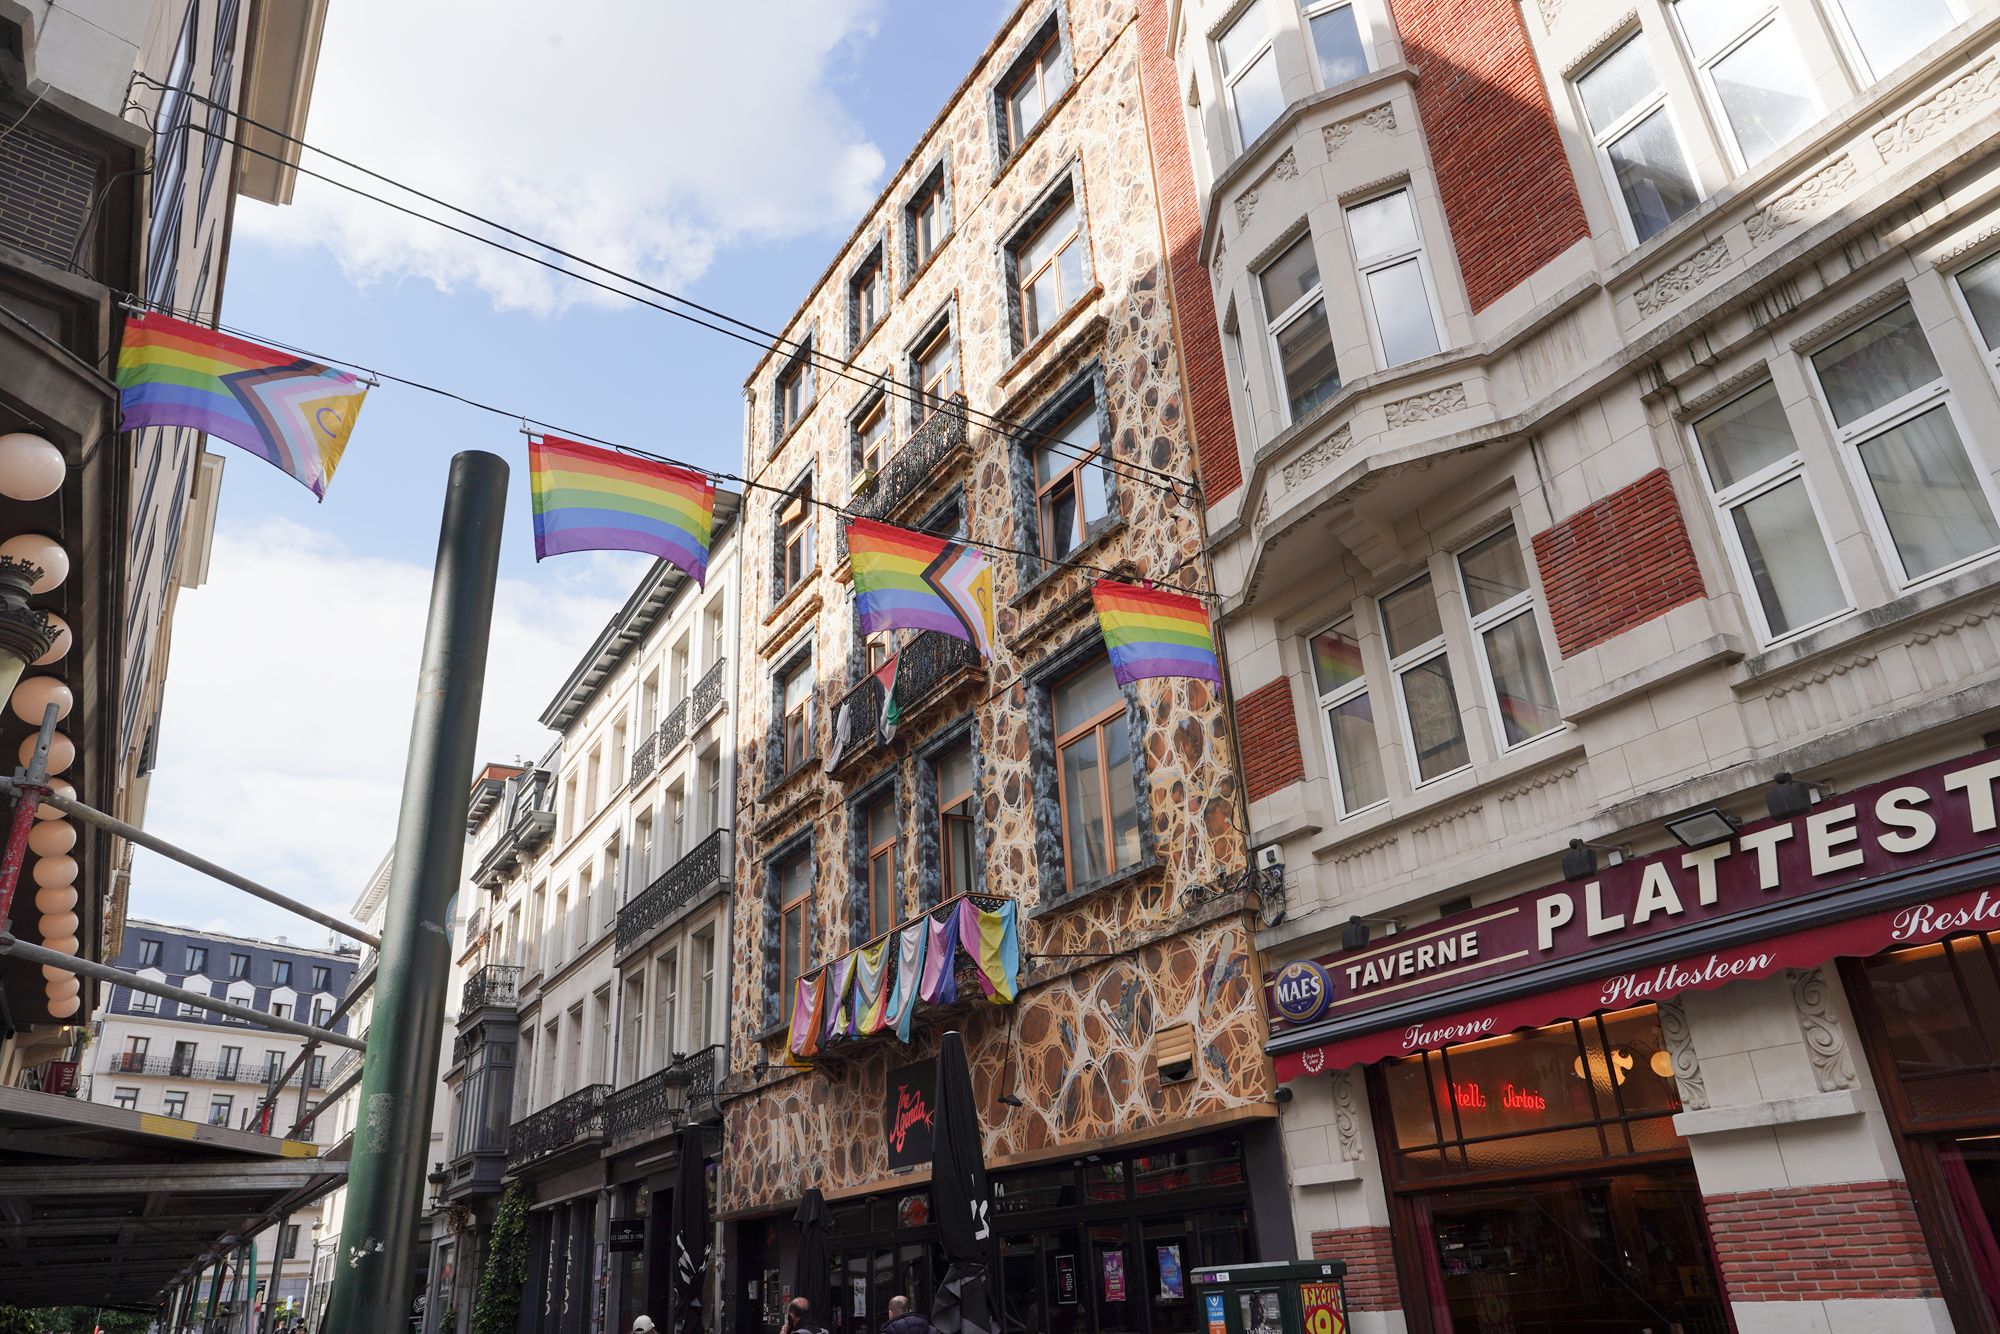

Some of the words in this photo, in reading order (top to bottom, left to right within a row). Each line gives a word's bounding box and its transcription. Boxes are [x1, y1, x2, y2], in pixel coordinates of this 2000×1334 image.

[1536, 759, 2000, 951] PLATTEST
[1346, 931, 1479, 990] TAVERNE
[1600, 952, 1777, 1005] Plattesteen
[1277, 974, 1321, 1005] MAES
[1402, 1016, 1497, 1050] Taverne
[889, 1091, 926, 1153] Agenda
[1503, 1082, 1547, 1111] Artois
